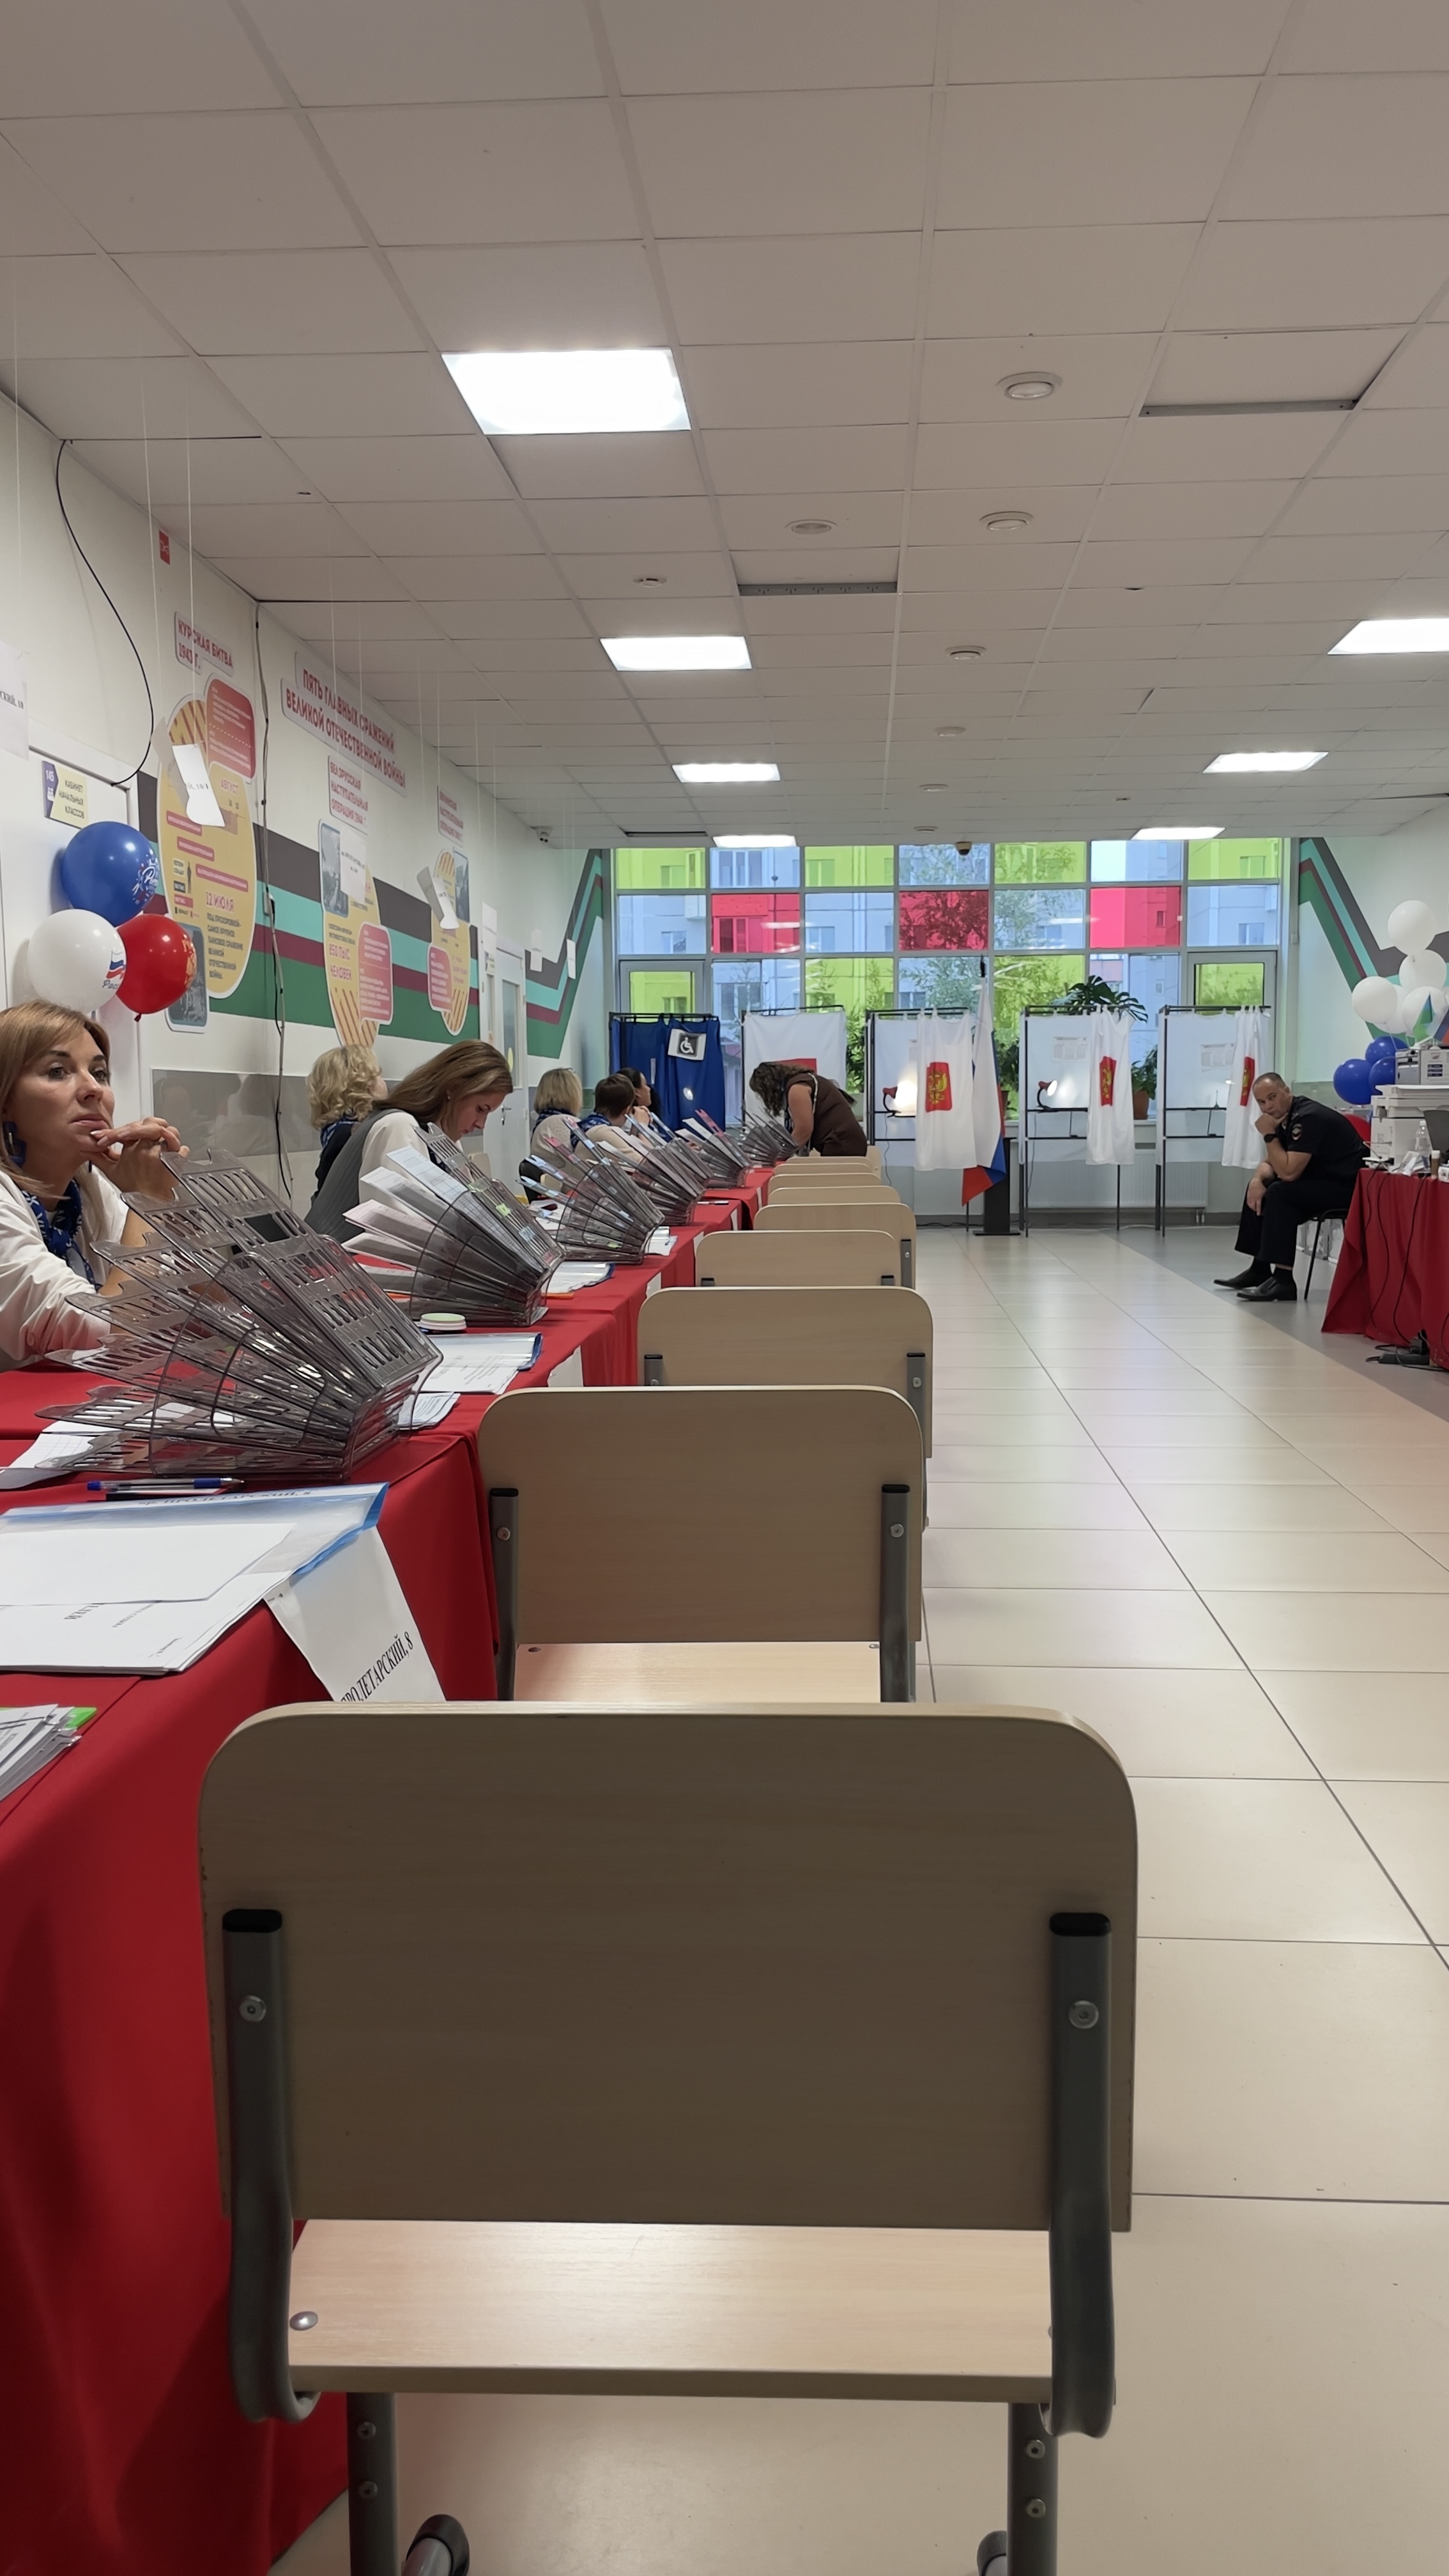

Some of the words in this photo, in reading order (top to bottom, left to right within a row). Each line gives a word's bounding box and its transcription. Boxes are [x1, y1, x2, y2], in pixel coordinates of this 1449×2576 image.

[179, 642, 193, 664] 1943
[211, 642, 233, 669] БИТВА
[303, 669, 323, 700] ПЯТЬ
[359, 714, 395, 755] СРАЖЕНИЙ
[286, 688, 324, 732] ВЕЛИКОЙ
[326, 717, 382, 772] ОТЕЧЕСТВЕННОЙ
[383, 758, 406, 788] ВОЙНЫ
[65, 806, 84, 819] КЛАССОВ
[206, 892, 213, 905] 12
[213, 894, 234, 912] ИЮЛЯ
[330, 965, 352, 981] ЧЕЛОВЕК
[404, 1631, 413, 1650] 8
